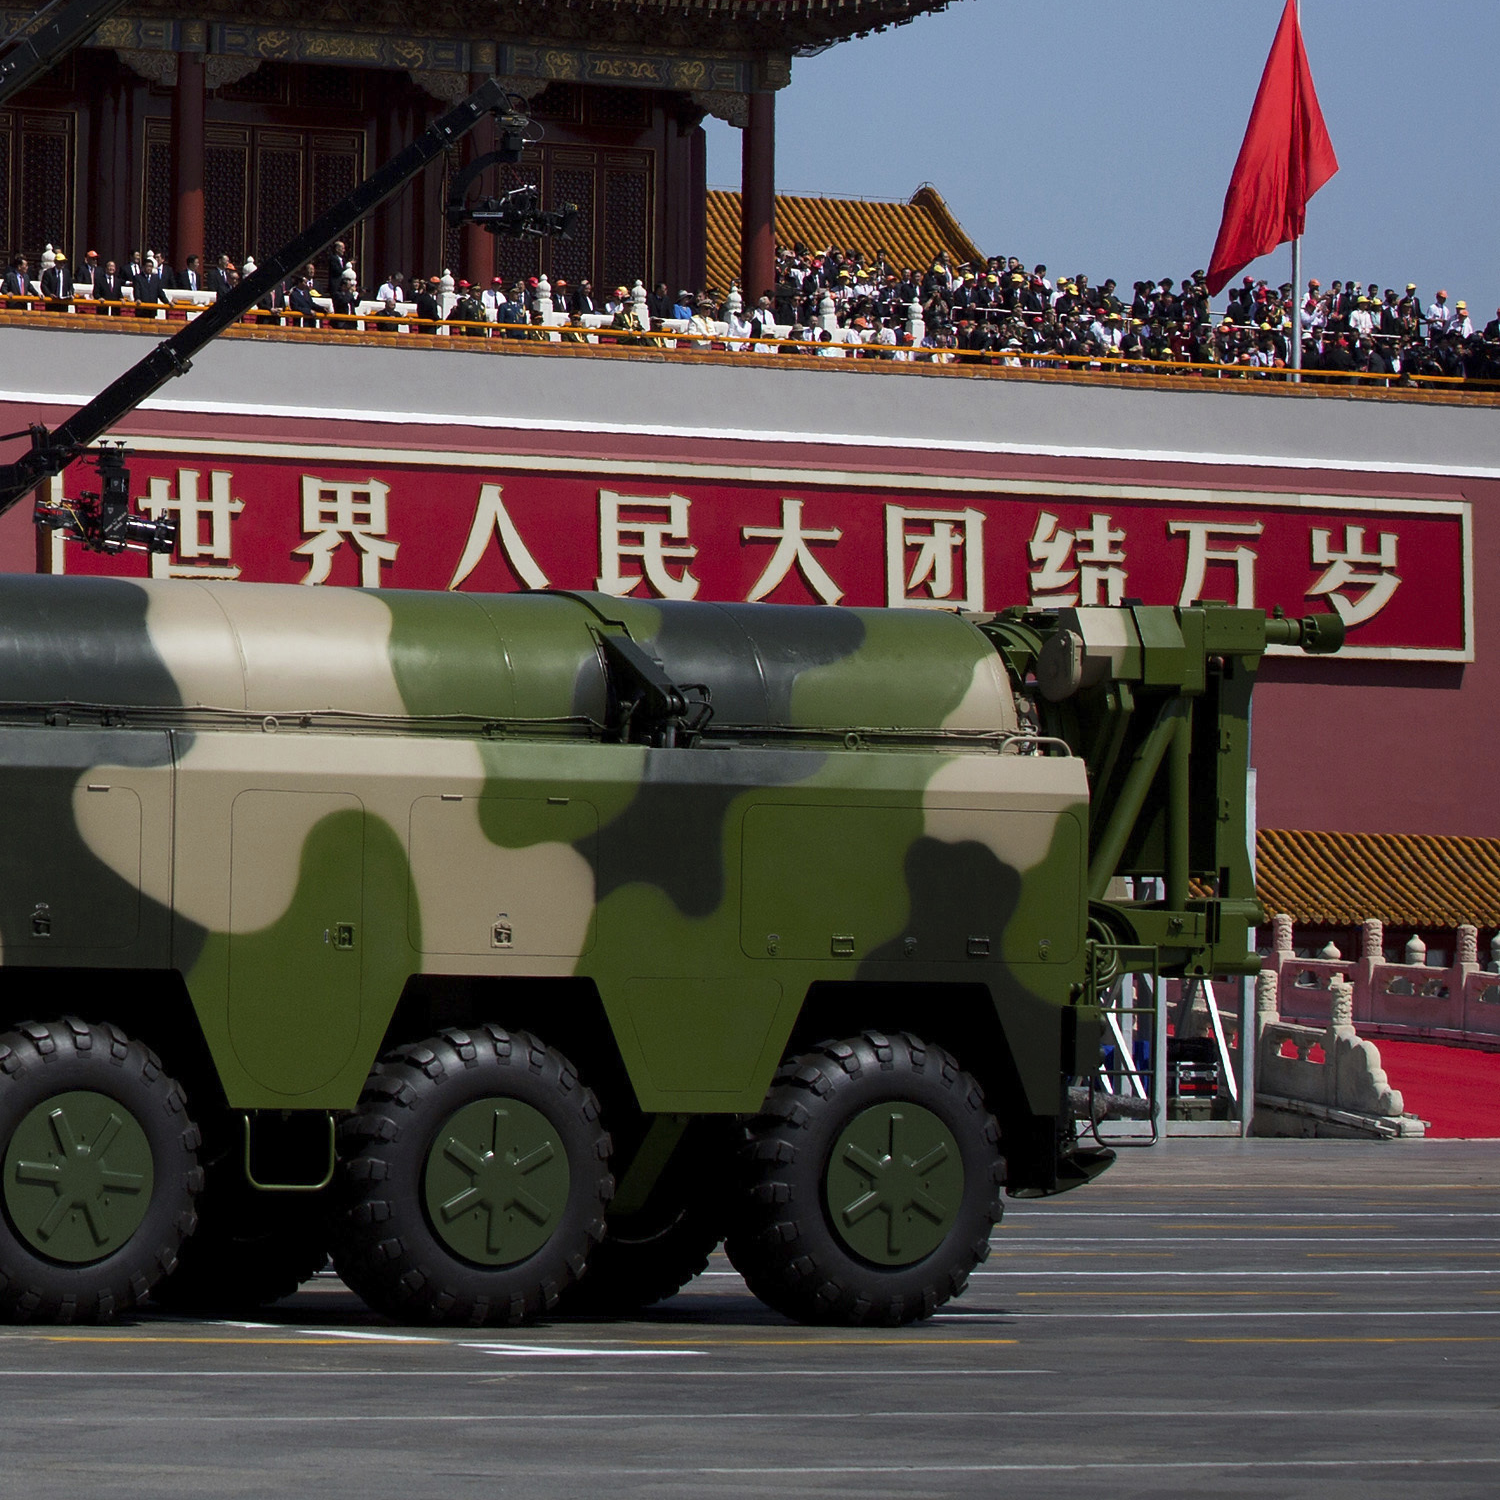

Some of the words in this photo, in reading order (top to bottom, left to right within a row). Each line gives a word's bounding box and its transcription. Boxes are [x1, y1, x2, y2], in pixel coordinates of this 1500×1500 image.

[138, 468, 1402, 628] 世界人民大团结万岁
